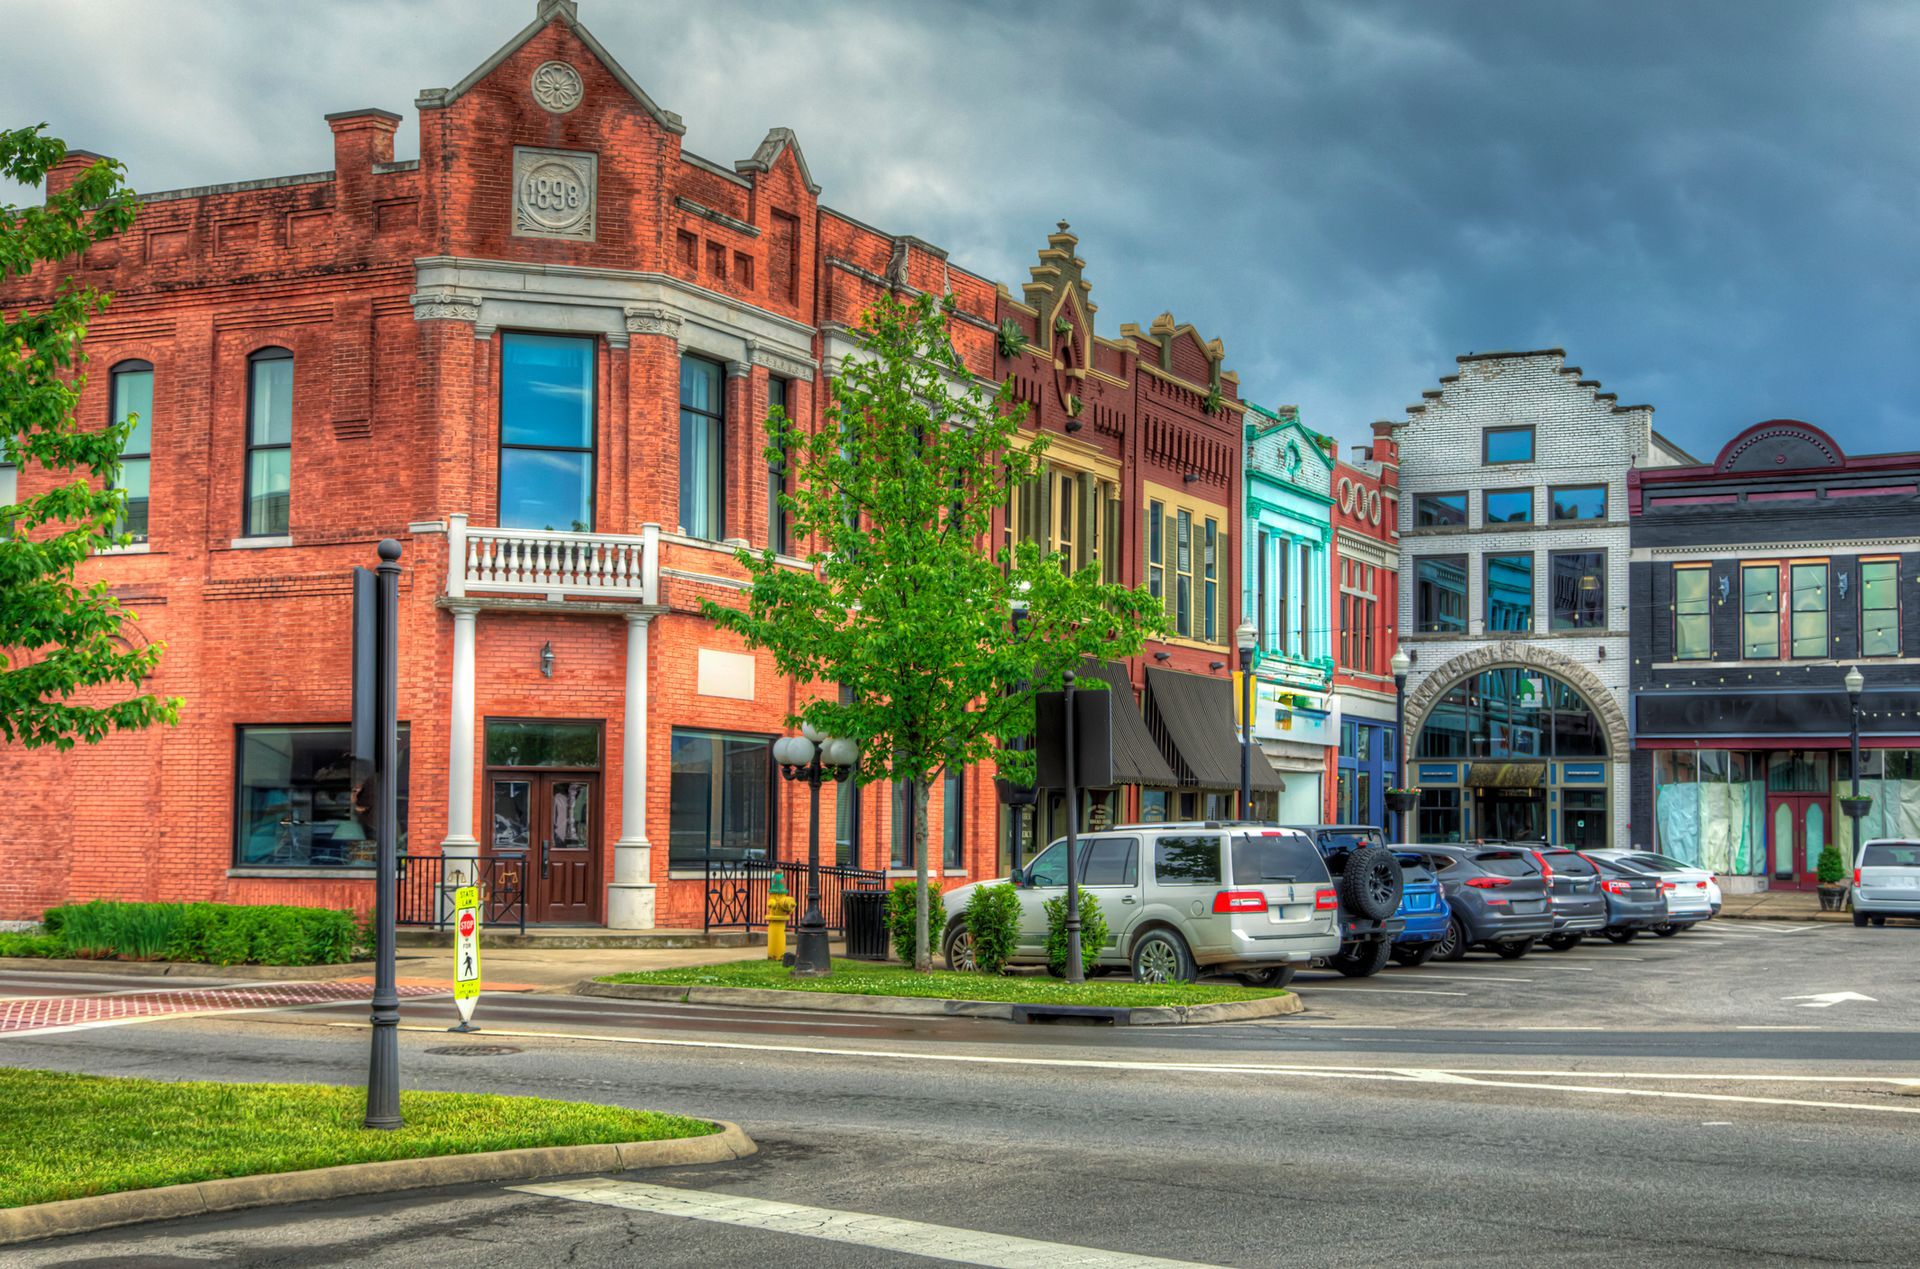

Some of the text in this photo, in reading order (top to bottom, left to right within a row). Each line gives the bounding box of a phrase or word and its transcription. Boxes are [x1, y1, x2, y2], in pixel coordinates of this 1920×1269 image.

[527, 176, 579, 211] 1898
[460, 889, 474, 898] STATE
[460, 920, 474, 930] STOP
